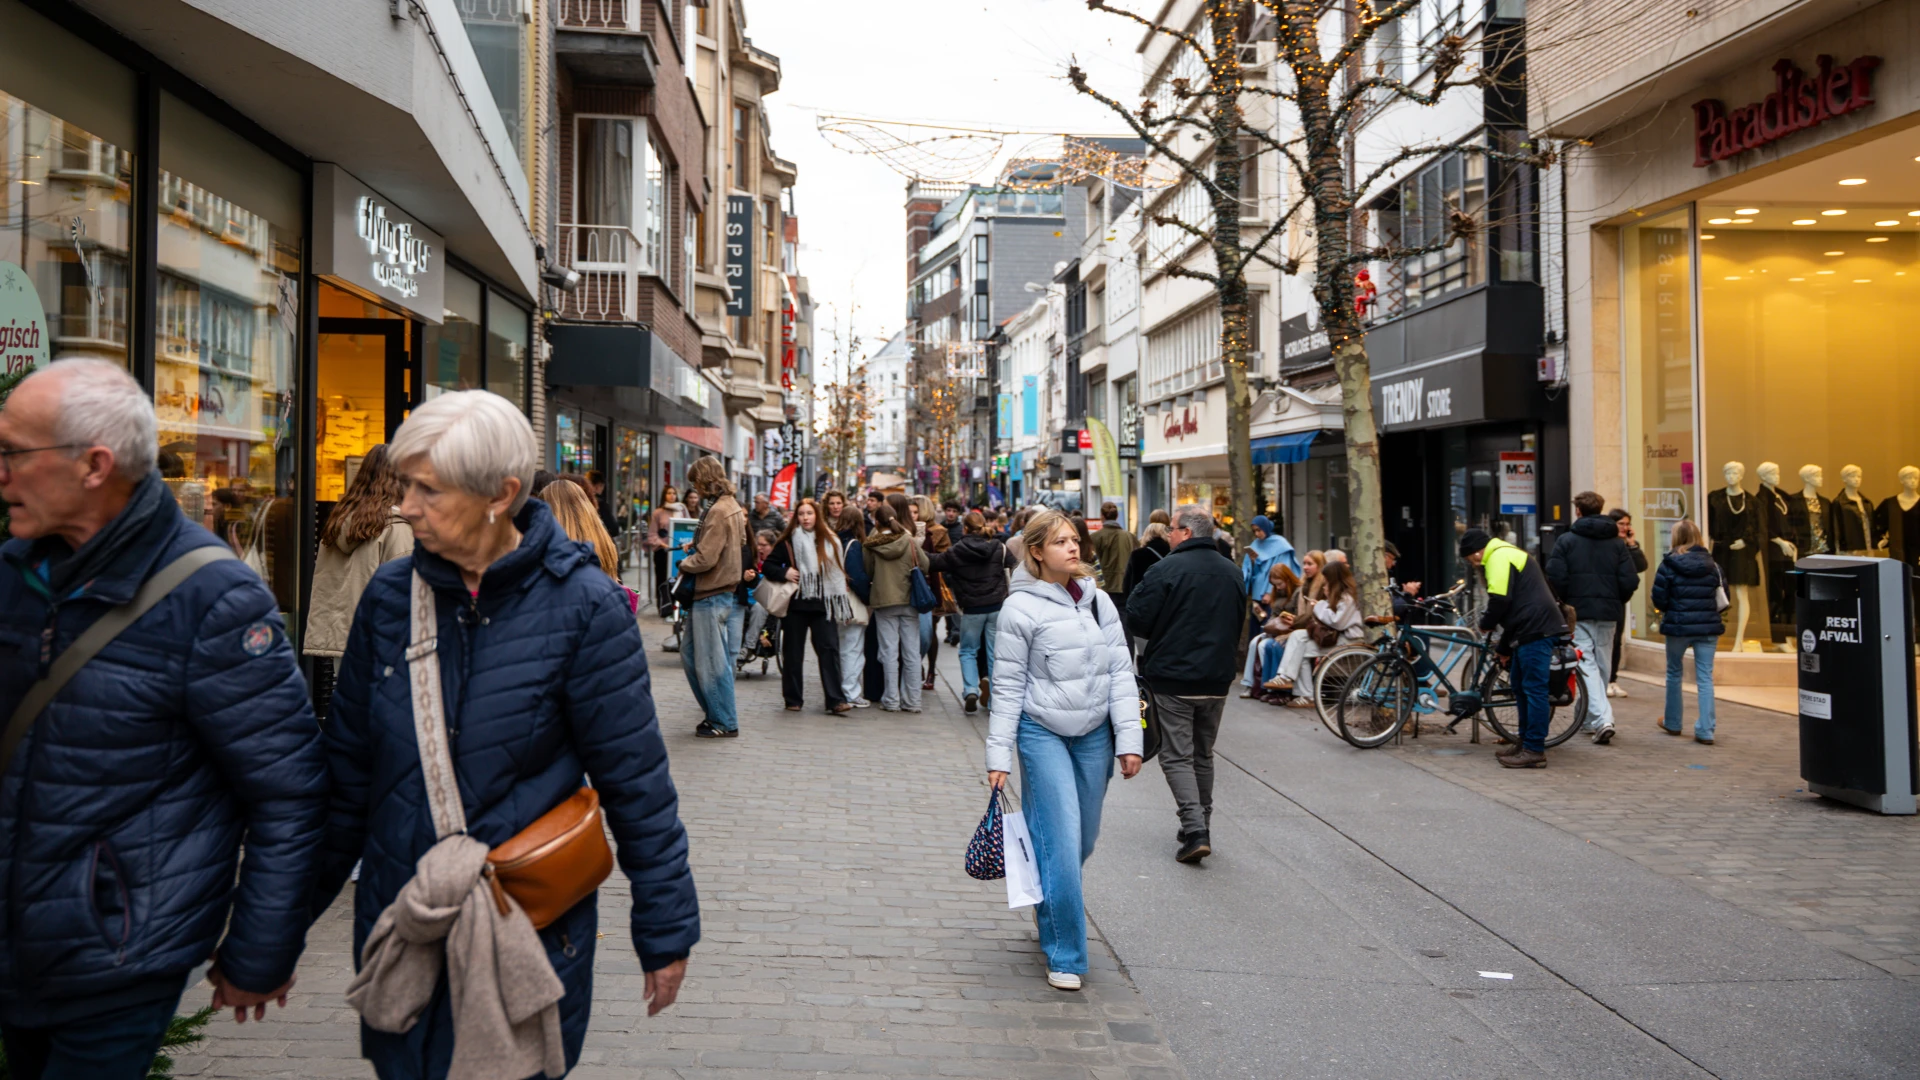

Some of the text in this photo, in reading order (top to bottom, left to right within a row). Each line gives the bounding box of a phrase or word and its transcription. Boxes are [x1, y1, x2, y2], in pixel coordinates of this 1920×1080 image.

[1691, 54, 1884, 168] Paradisier
[727, 201, 743, 310] ESPRIT
[1382, 377, 1451, 425] TRENDY STORE
[1646, 446, 1678, 458] Paradisier
[1506, 464, 1533, 474] MCA
[1826, 616, 1857, 629] REST
[1819, 630, 1858, 644] AFVAL
